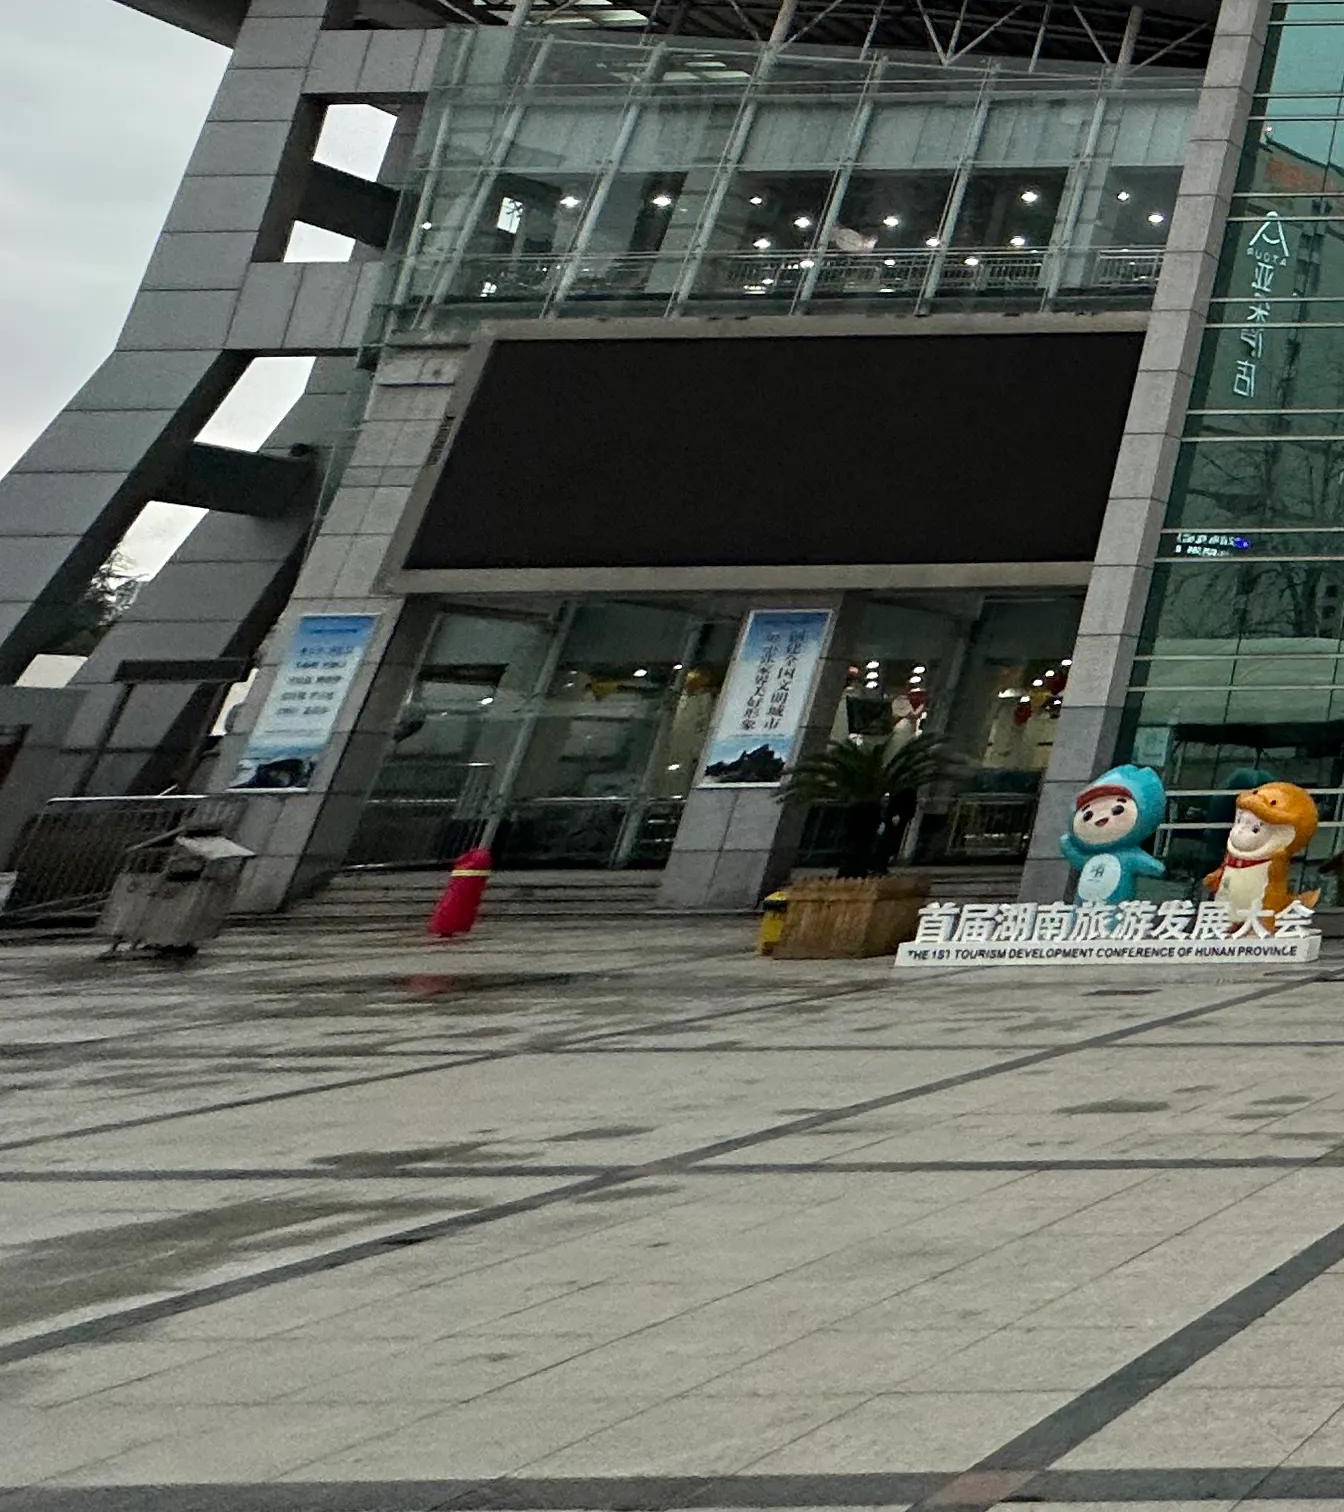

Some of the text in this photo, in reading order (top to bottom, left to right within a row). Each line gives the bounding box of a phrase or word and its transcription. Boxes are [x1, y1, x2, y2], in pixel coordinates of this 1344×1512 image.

[915, 900, 1316, 944] 首届湖南旅游发展大会
[908, 949, 928, 960] THE
[955, 948, 1006, 960] TOURISM
[1009, 947, 1093, 959] DEVELOPMENT
[1096, 947, 1175, 959] CONFERENCE
[1177, 947, 1193, 958] OF
[1195, 946, 1236, 957] HUNAN
[1237, 945, 1298, 957] PROVINCE
